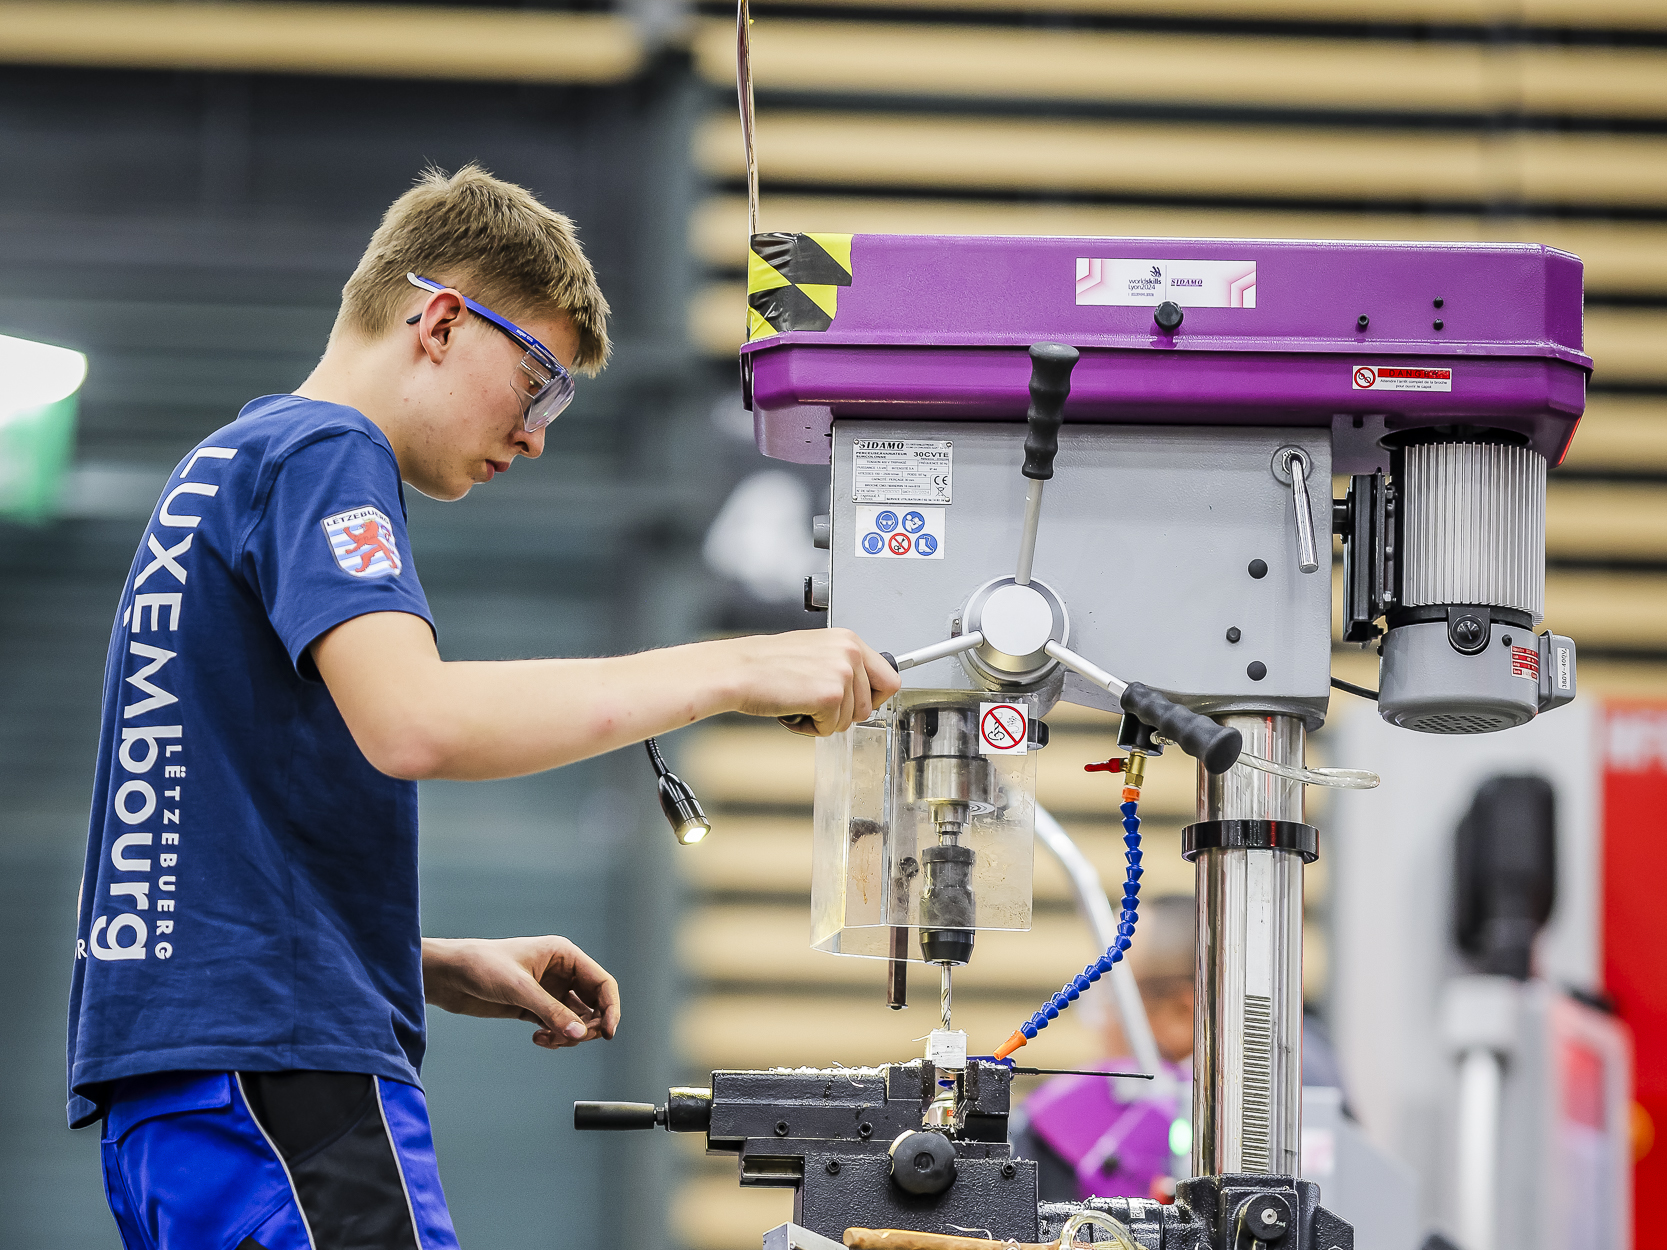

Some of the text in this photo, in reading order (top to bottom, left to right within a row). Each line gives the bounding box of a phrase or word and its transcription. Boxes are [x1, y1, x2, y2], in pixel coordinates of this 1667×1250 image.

[1170, 278, 1203, 287] SIDAMO
[858, 441, 905, 450] SIDAMO
[154, 744, 186, 960] LËTZEBUERG
